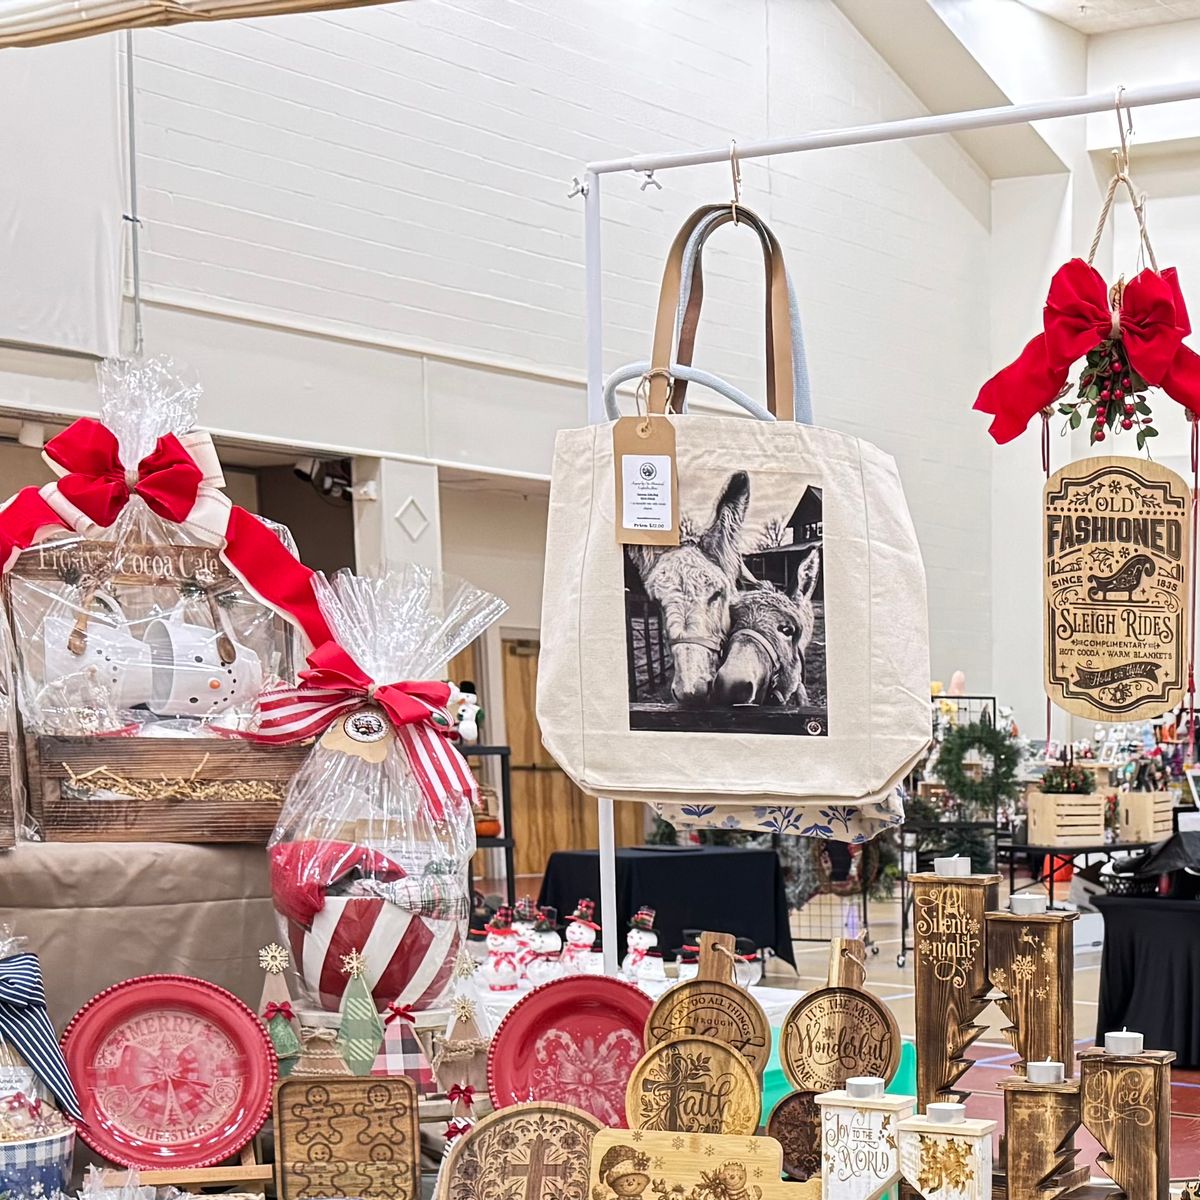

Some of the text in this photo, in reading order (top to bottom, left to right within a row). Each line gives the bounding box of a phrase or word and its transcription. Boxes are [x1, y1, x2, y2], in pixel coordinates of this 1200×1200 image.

[1095, 497, 1135, 513] OLD
[1046, 514, 1183, 561] FASHIONED
[119, 551, 174, 577] Cocoa
[1051, 575, 1178, 592] SINCE 1835
[1059, 648, 1173, 660] HOT COCOA WARM BLANKETS
[1083, 639, 1148, 649] COMPLIMENTARY
[916, 897, 968, 936] Silent
[932, 933, 980, 974] night
[687, 1016, 734, 1027] THROUGH
[691, 997, 706, 1007] DO
[707, 997, 725, 1007] ALL
[726, 1001, 751, 1036] THINGS
[827, 998, 851, 1010] THE
[852, 1002, 880, 1029] MOST
[127, 1015, 199, 1040] MERRY
[788, 1020, 892, 1070] Wonderful
[794, 1056, 815, 1083] TIME
[852, 1129, 873, 1140] TO THE
